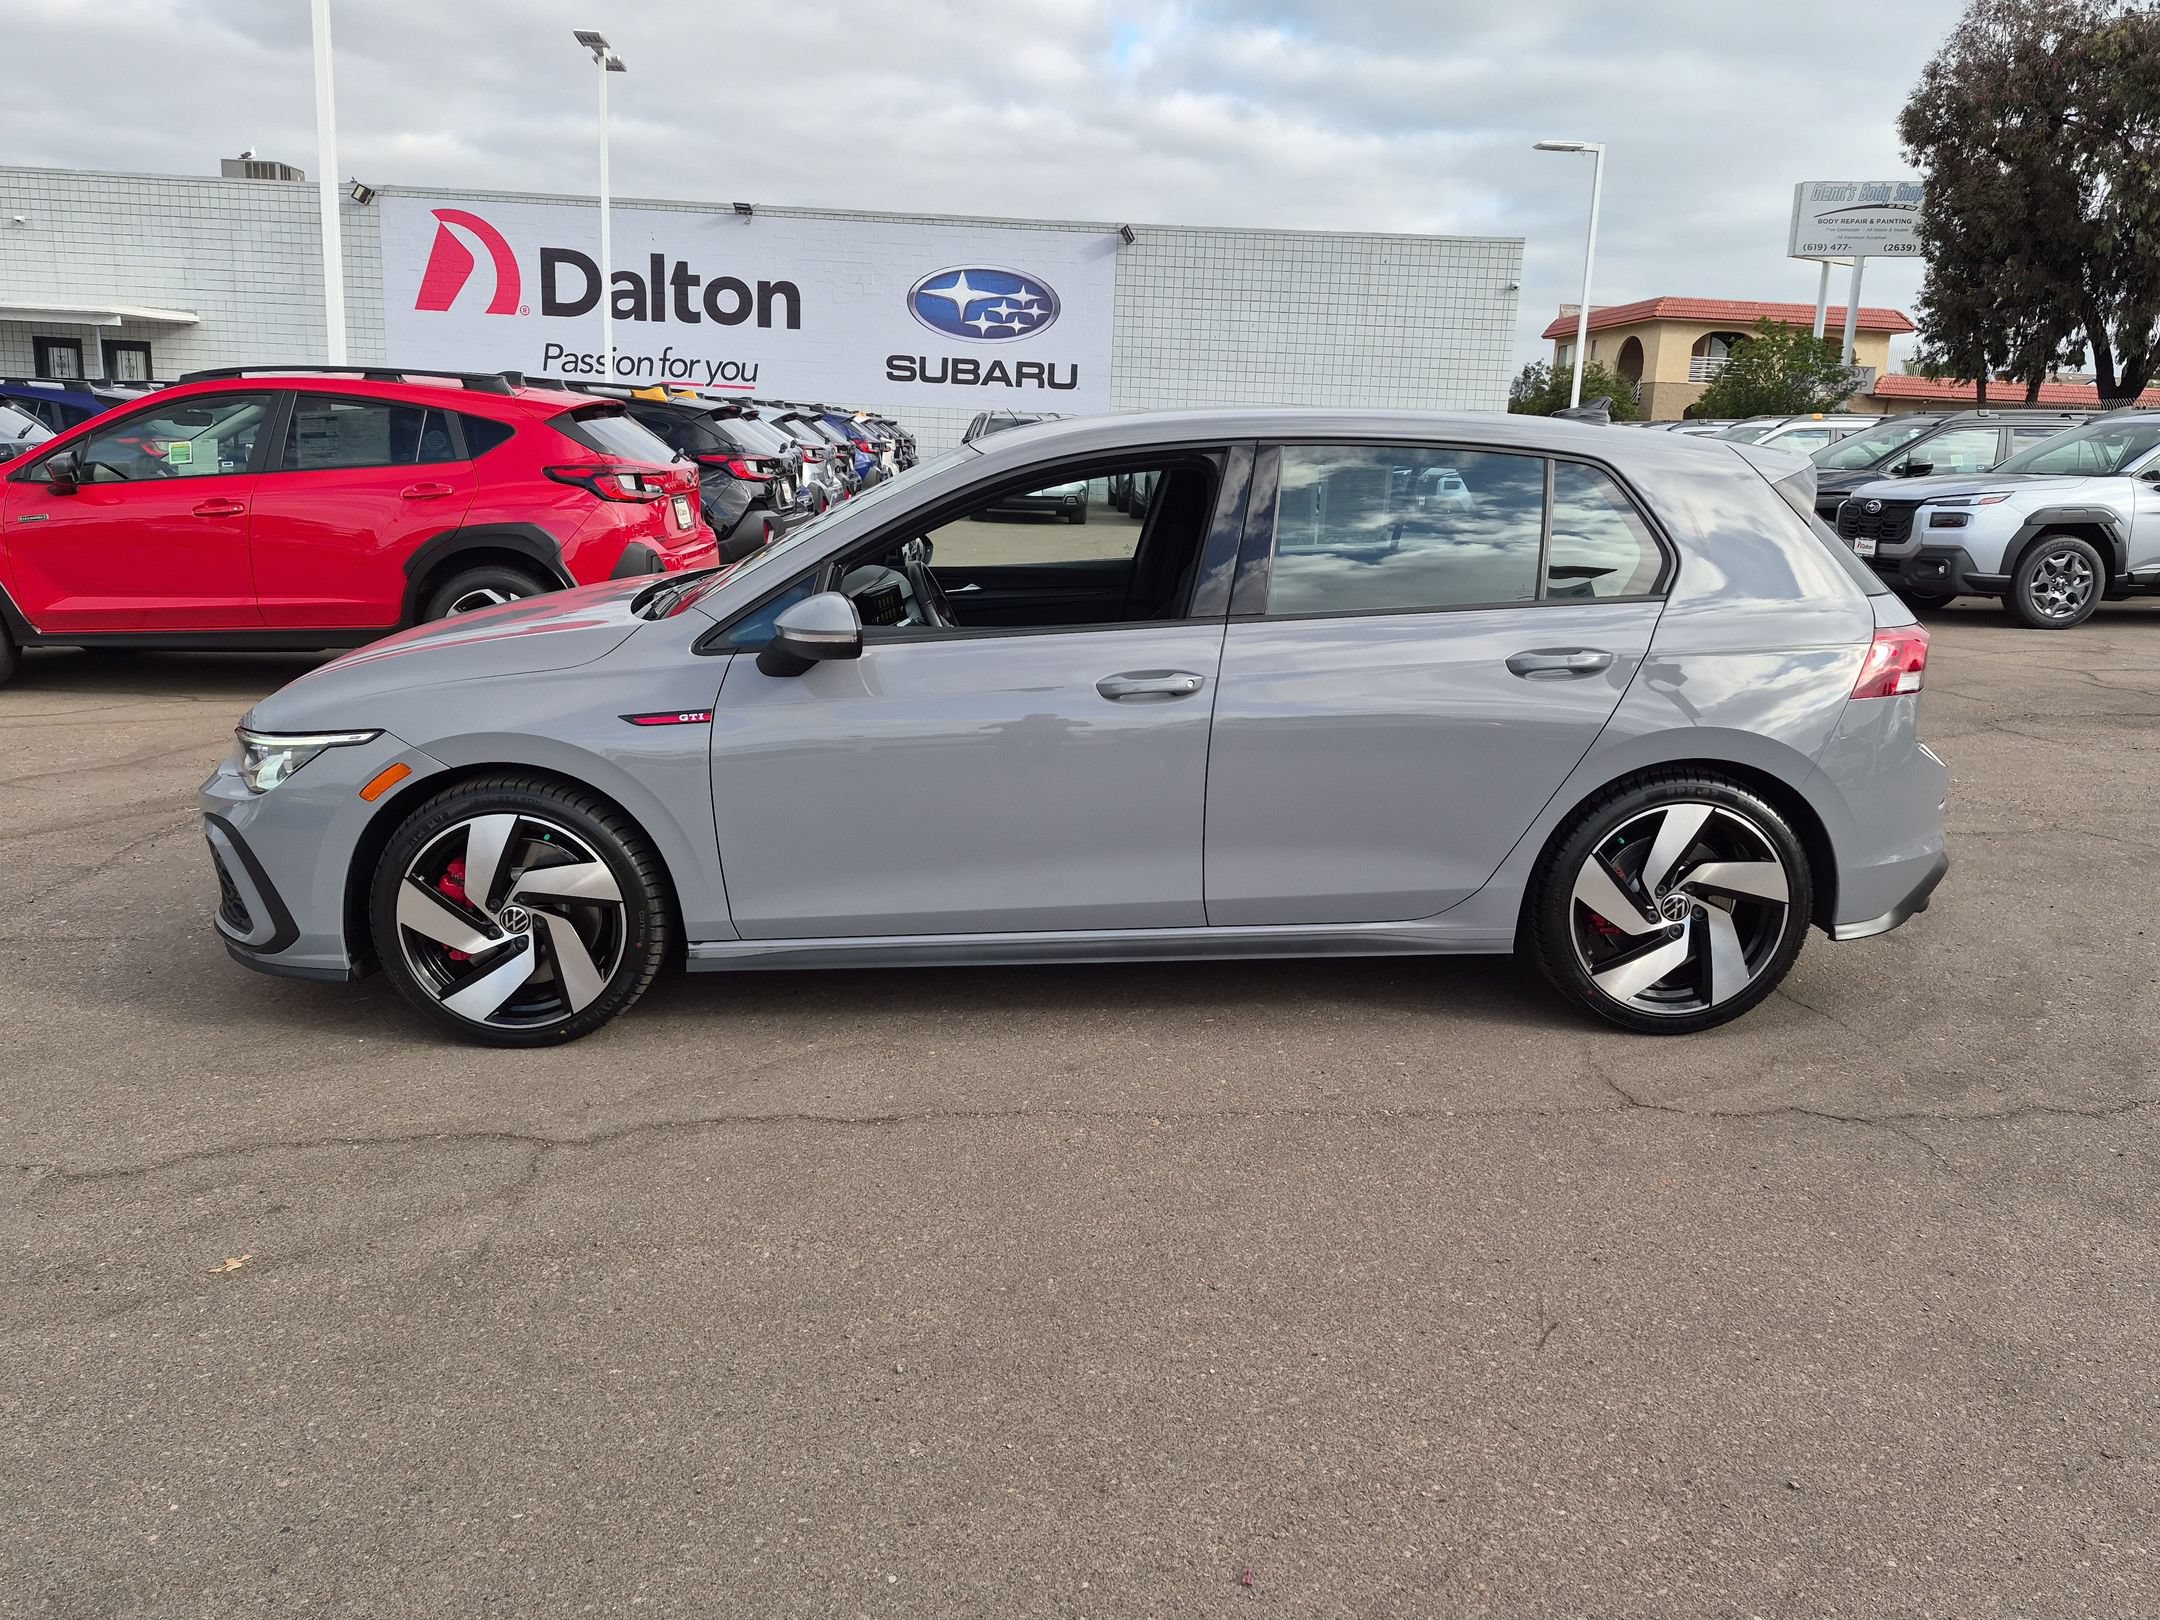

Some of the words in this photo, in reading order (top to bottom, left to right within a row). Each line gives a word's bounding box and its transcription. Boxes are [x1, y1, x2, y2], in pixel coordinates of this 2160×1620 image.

[1810, 183, 1857, 201] Glenn's
[1858, 183, 1892, 206] Body
[1894, 183, 1924, 204] Shop
[1802, 243, 1828, 252] (619)
[1829, 243, 1853, 252] 477-
[1883, 243, 1917, 252] (2639)
[540, 247, 801, 330] Dalton
[543, 342, 654, 378] Passion
[659, 346, 702, 379] for
[705, 359, 759, 387] you
[886, 354, 1079, 391] SUBARU
[678, 713, 704, 722] GTI
